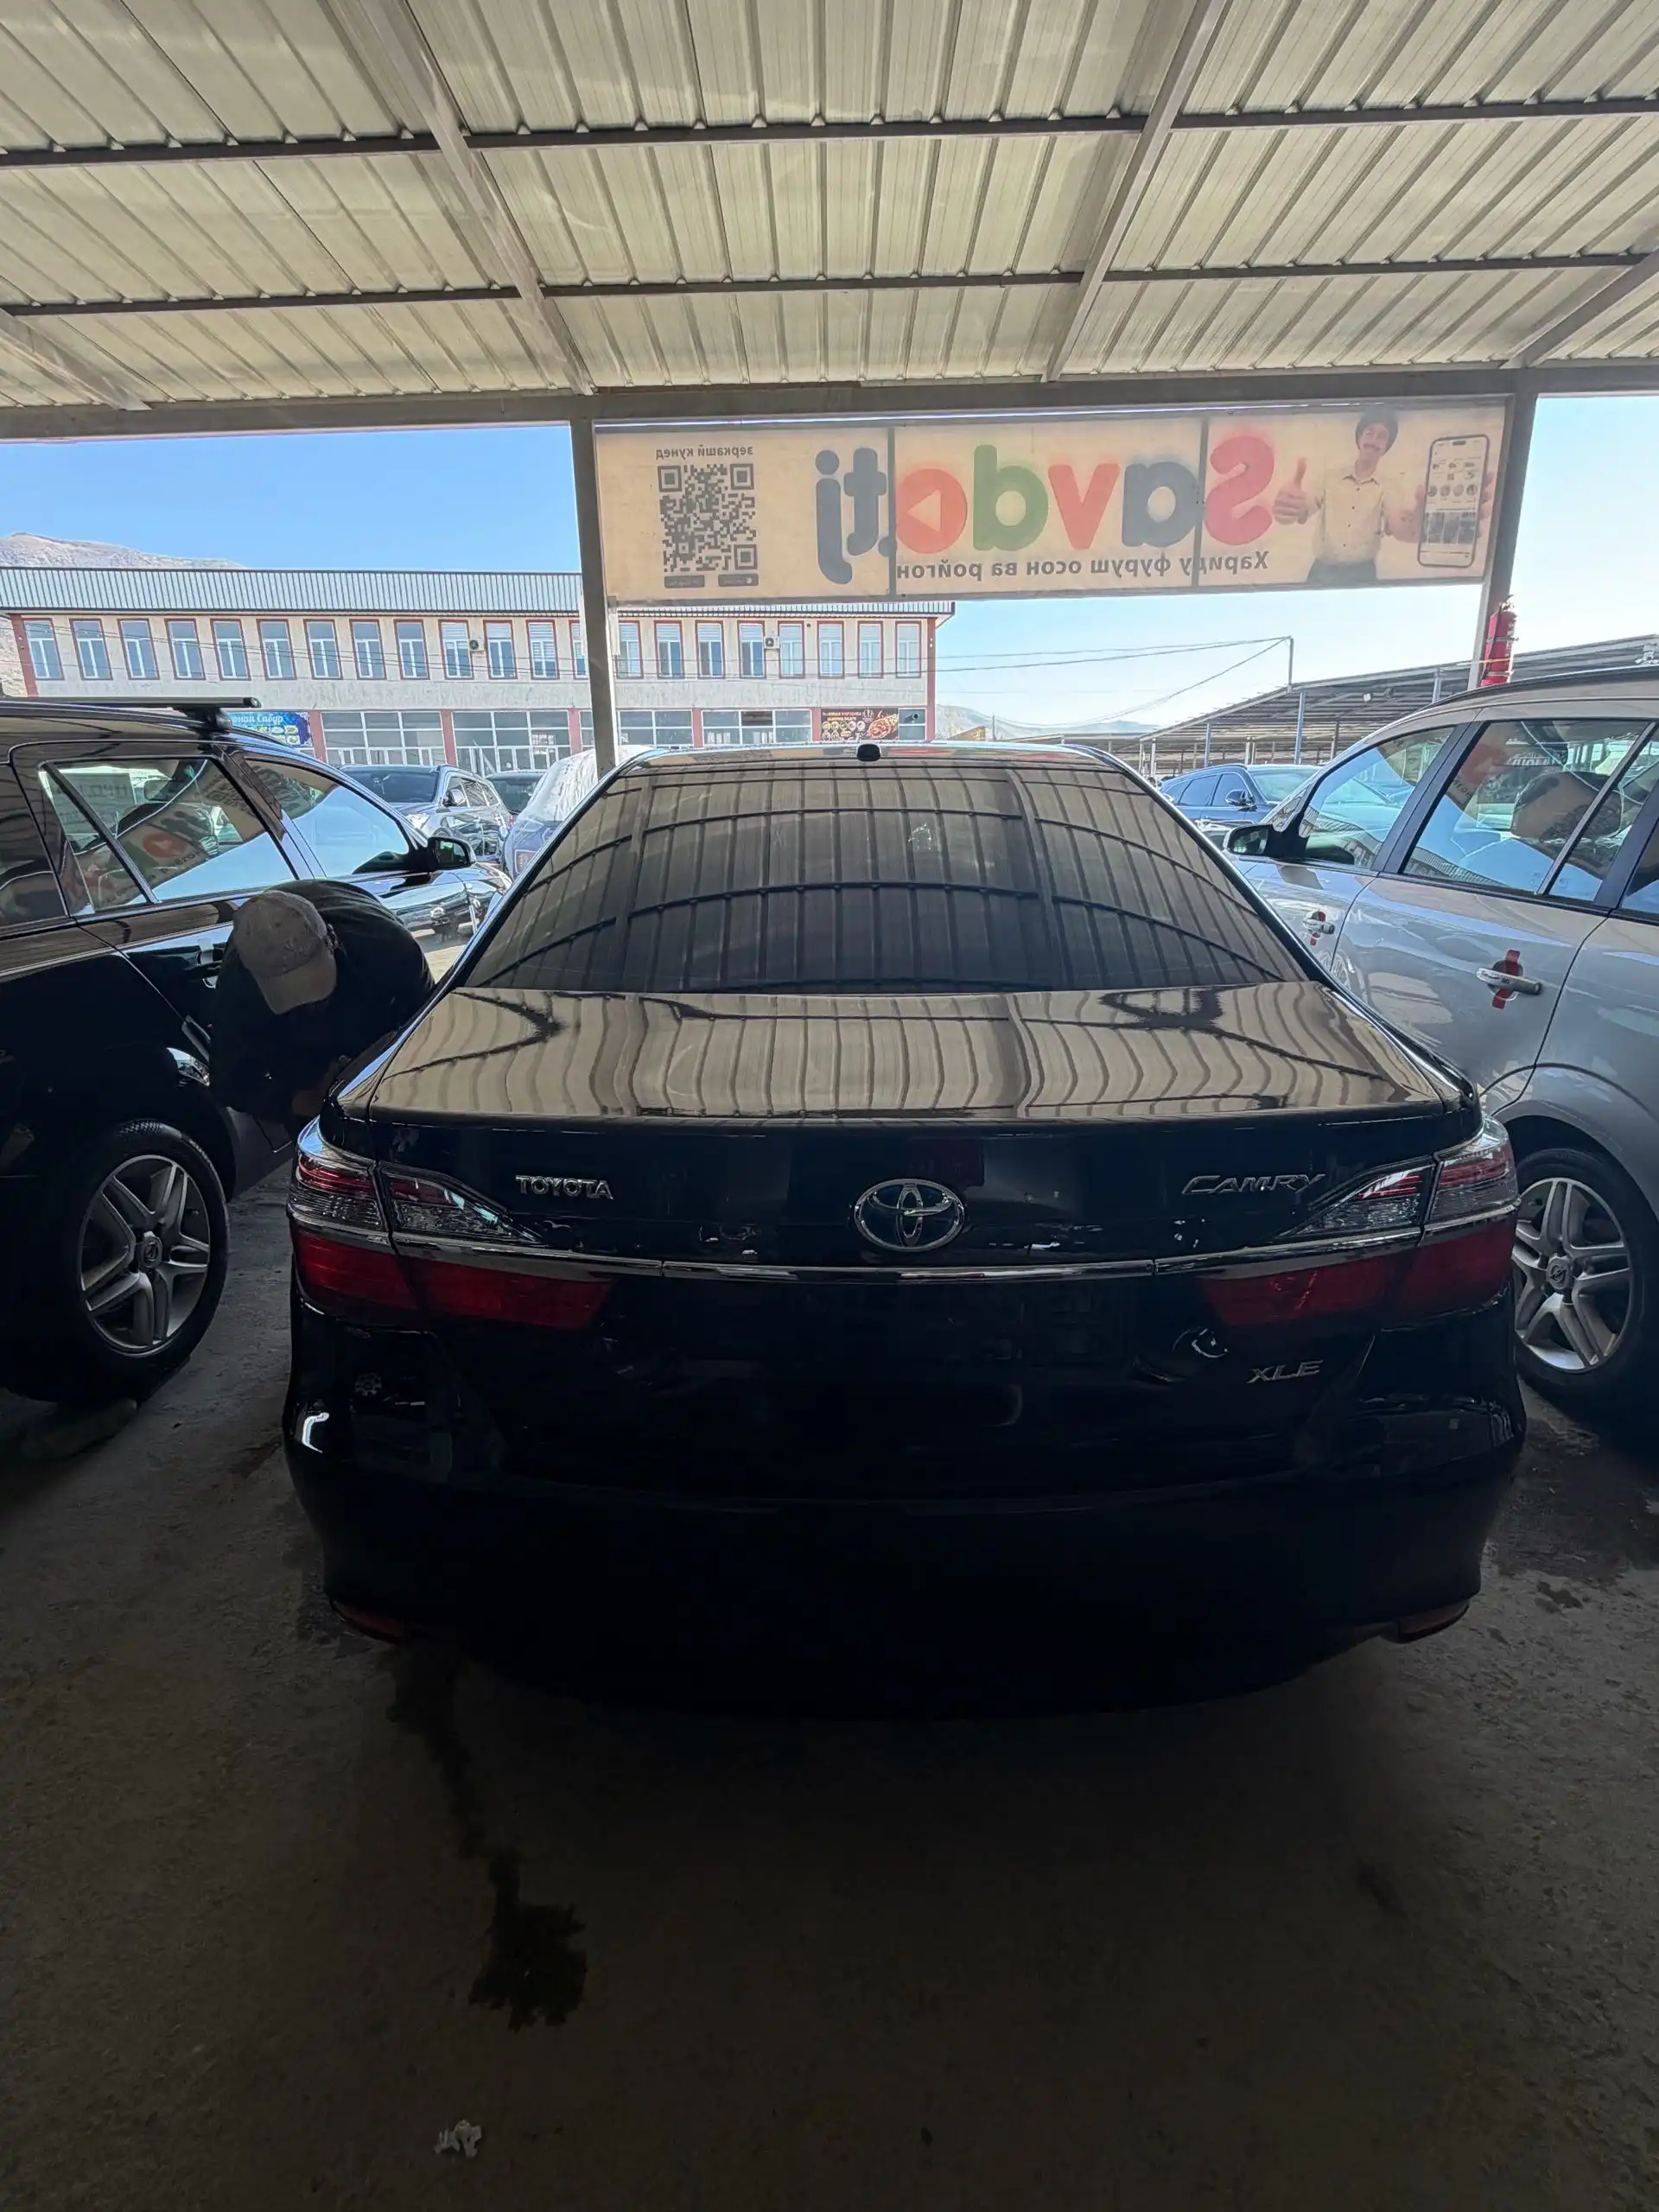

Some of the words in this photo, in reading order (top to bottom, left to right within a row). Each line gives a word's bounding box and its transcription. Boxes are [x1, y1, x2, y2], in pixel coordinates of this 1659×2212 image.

[516, 1175, 613, 1200] TOYOTA
[1181, 1173, 1326, 1194] CAMRY
[1246, 1359, 1323, 1383] XLE
